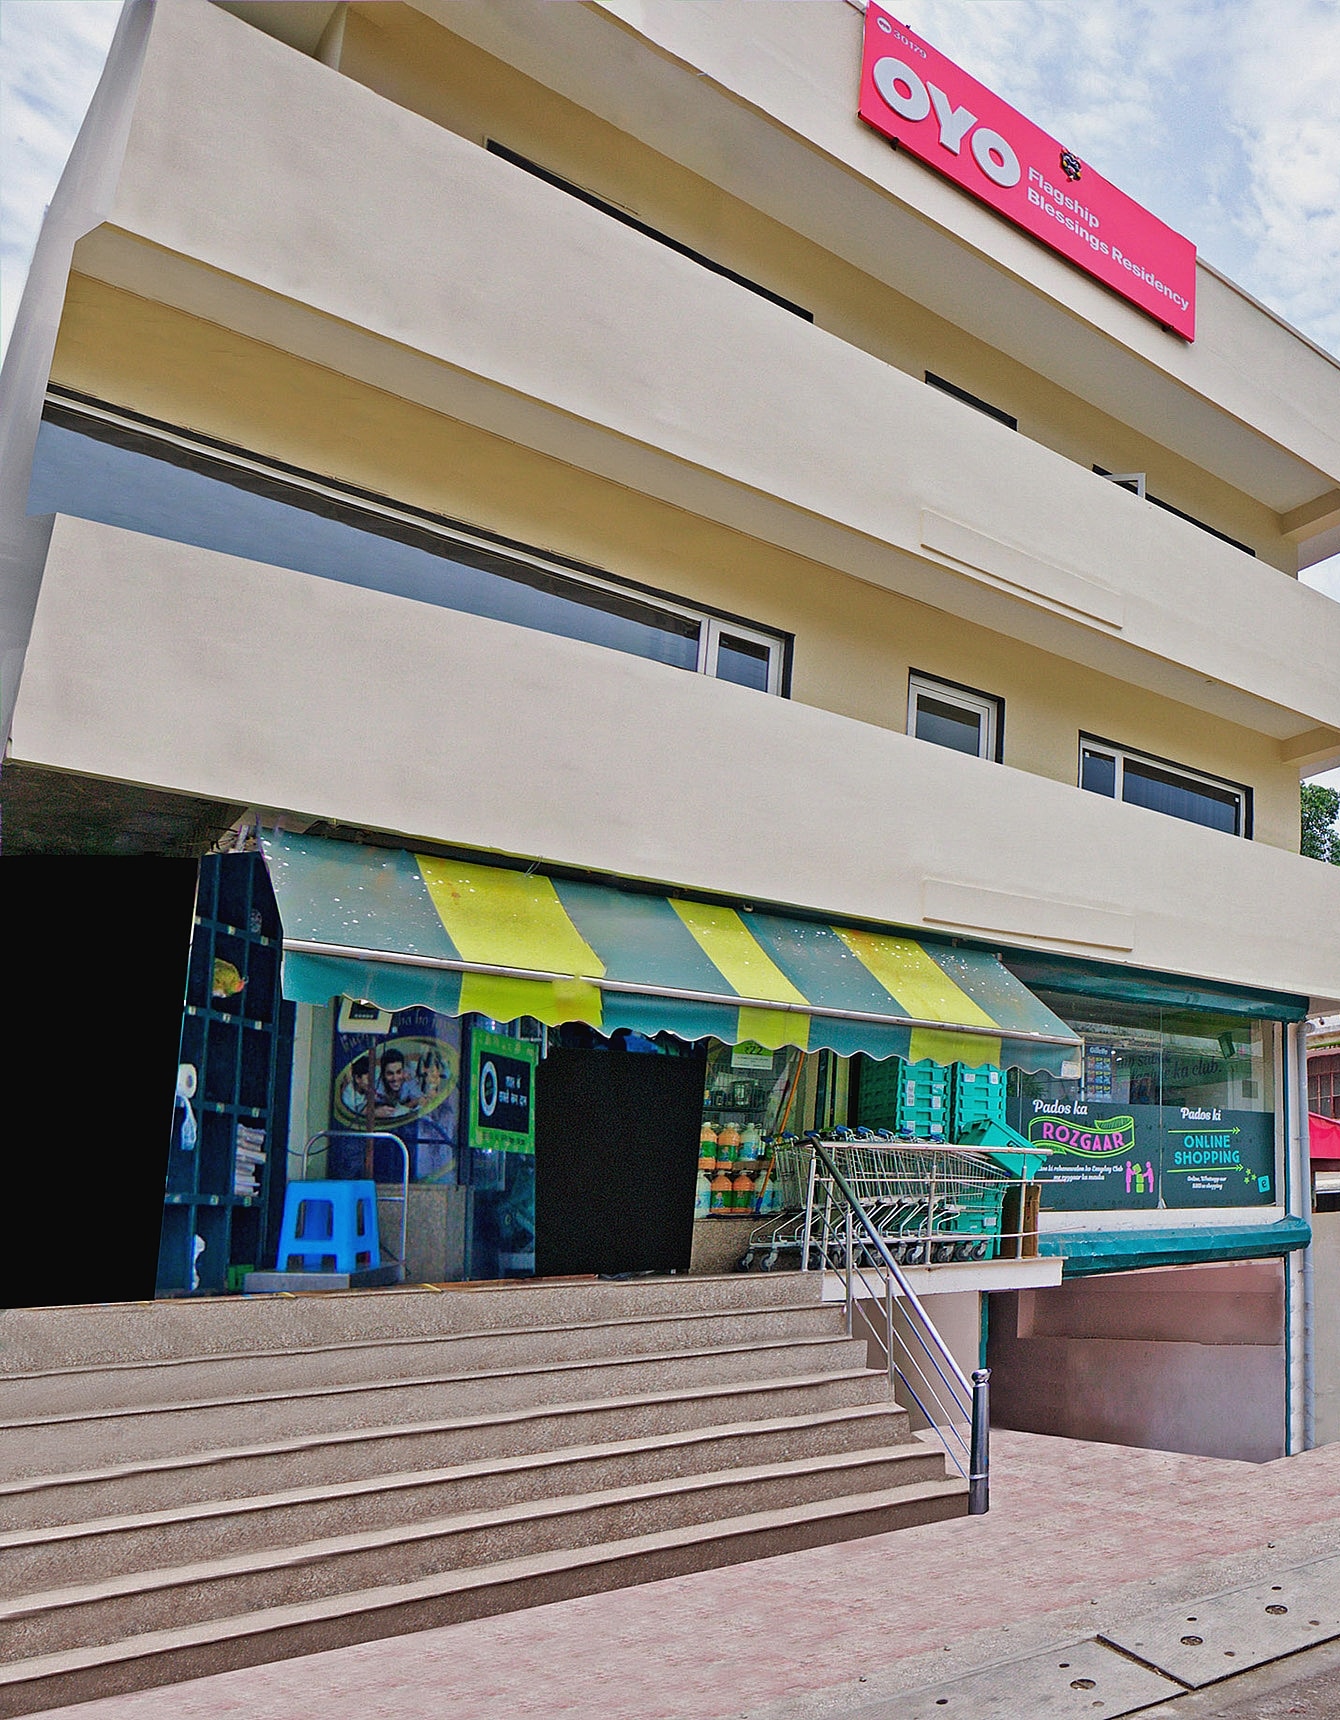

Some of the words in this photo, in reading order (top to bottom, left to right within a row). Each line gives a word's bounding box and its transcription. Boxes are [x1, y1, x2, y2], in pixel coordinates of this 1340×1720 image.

[893, 28, 927, 59] 30179
[873, 56, 1021, 189] OYO
[1028, 166, 1101, 229] Flagship
[1027, 187, 1110, 256] Blessings
[1111, 245, 1190, 311] Residency
[1032, 1099, 1072, 1116] Pados
[1073, 1100, 1088, 1115] ka
[1180, 1107, 1212, 1121] Pados
[1212, 1108, 1222, 1122] ki
[1042, 1122, 1125, 1152] ROZGAAR
[1184, 1135, 1231, 1149] ONLINE
[1174, 1150, 1240, 1165] SHOPPING
